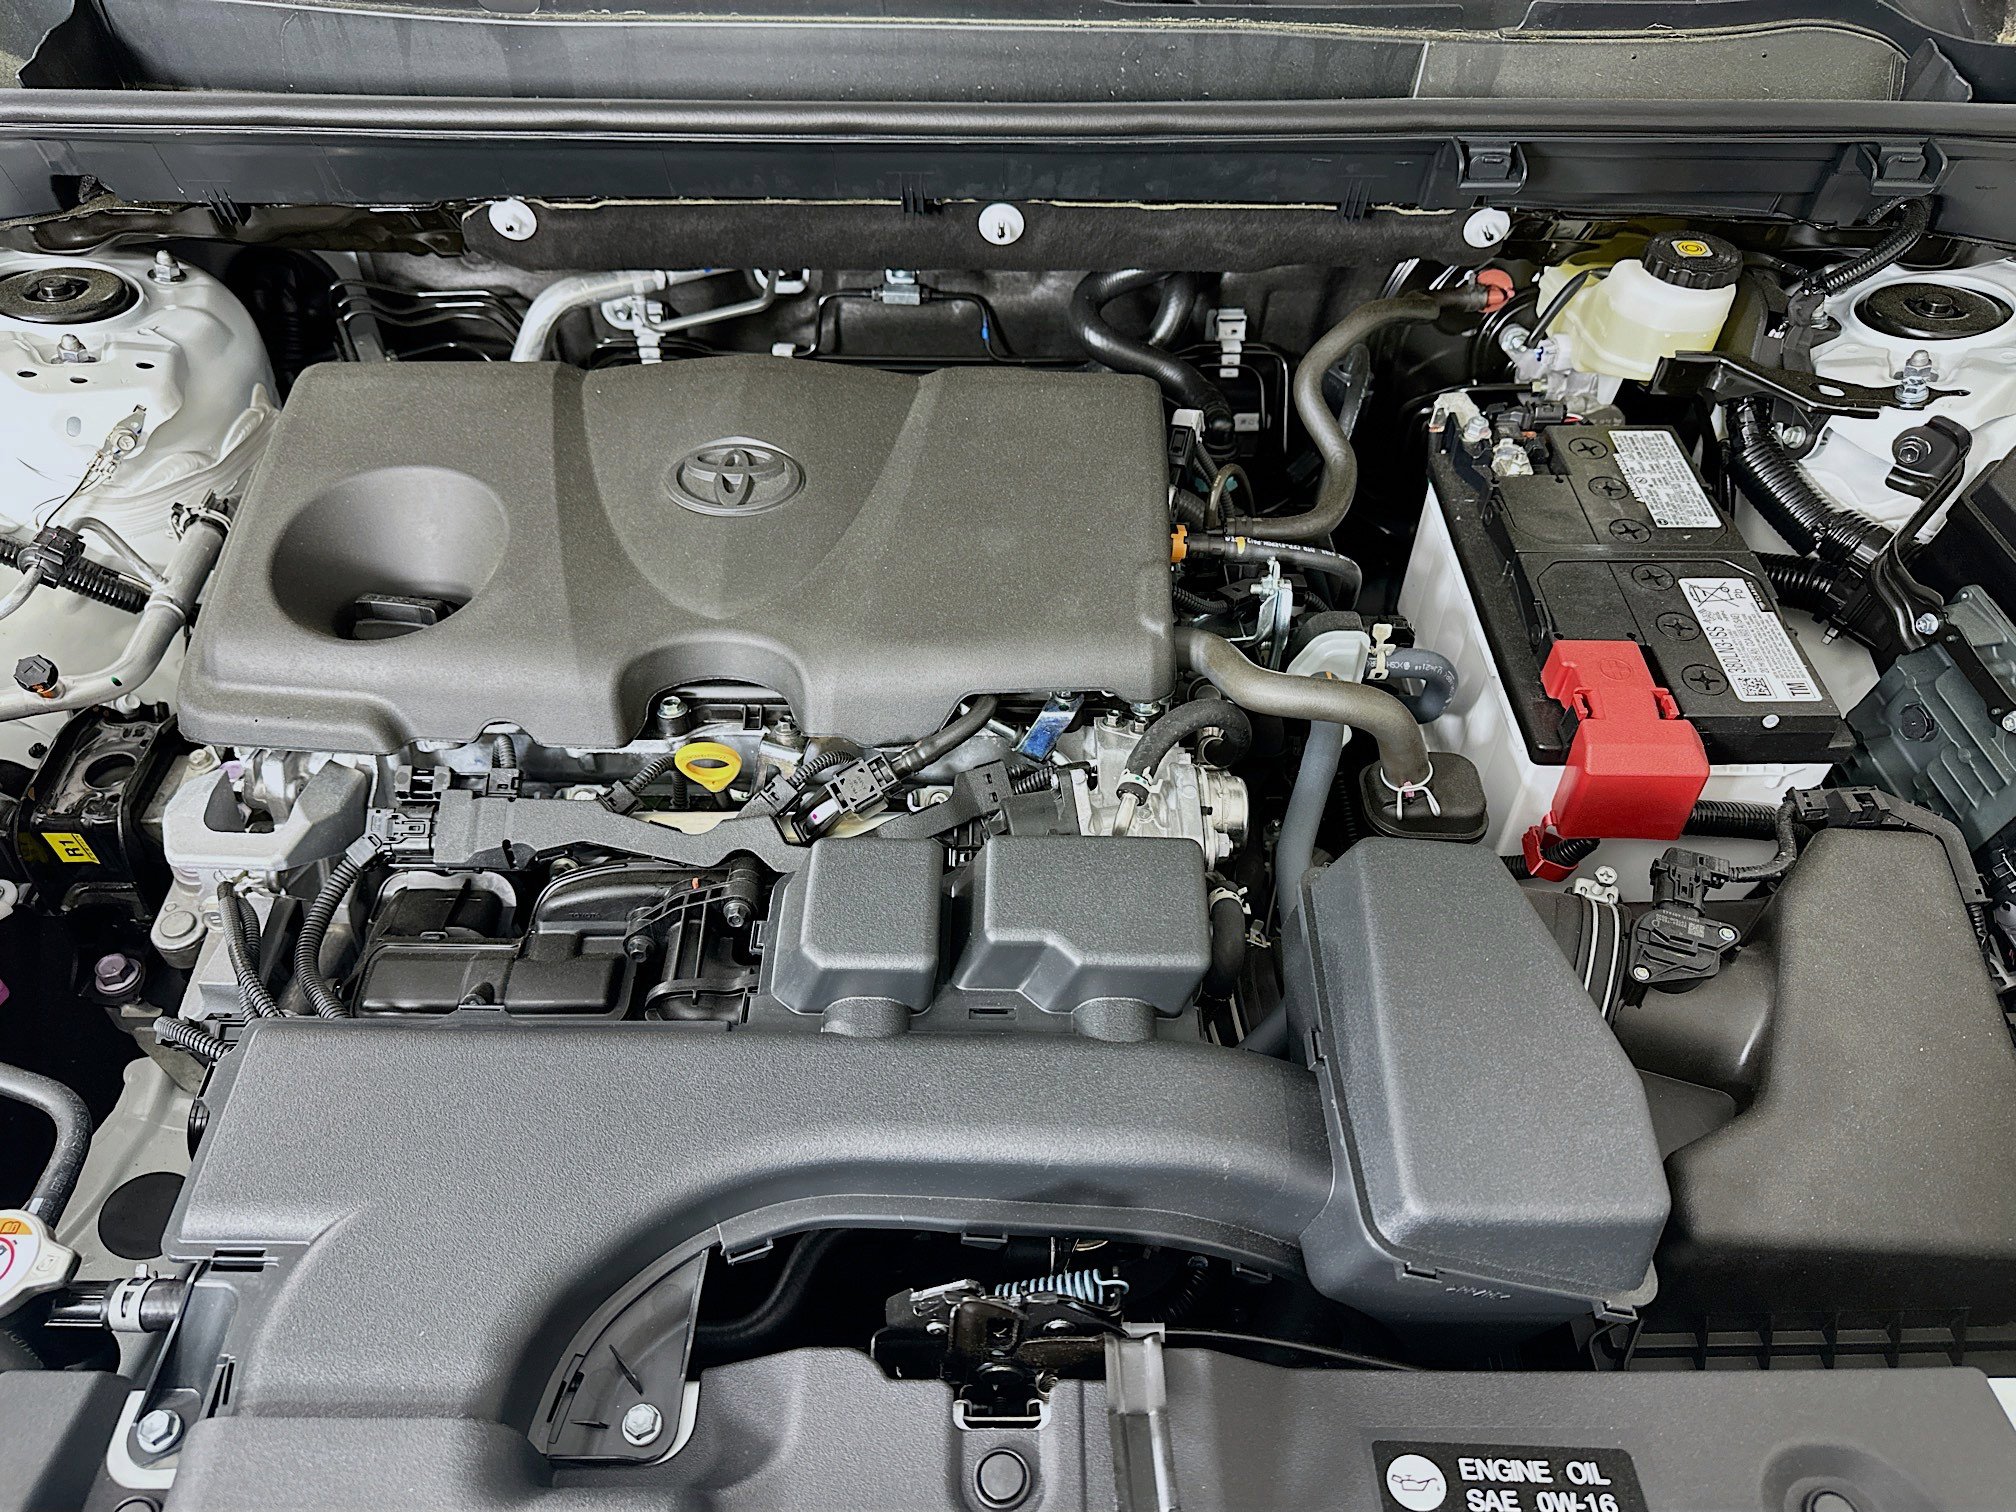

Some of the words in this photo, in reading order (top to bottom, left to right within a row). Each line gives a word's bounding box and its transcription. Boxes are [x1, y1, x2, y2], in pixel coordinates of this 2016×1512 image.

[1733, 588, 1746, 599] Pb
[1705, 626, 1747, 673] 380LN3-ISS
[1786, 682, 1811, 696] TM
[59, 840, 84, 857] R1
[1457, 1457, 1554, 1484] ENGINE
[1565, 1461, 1611, 1486] OIL
[1466, 1488, 1522, 1512] SAE
[1536, 1491, 1619, 1512] 0W-16
